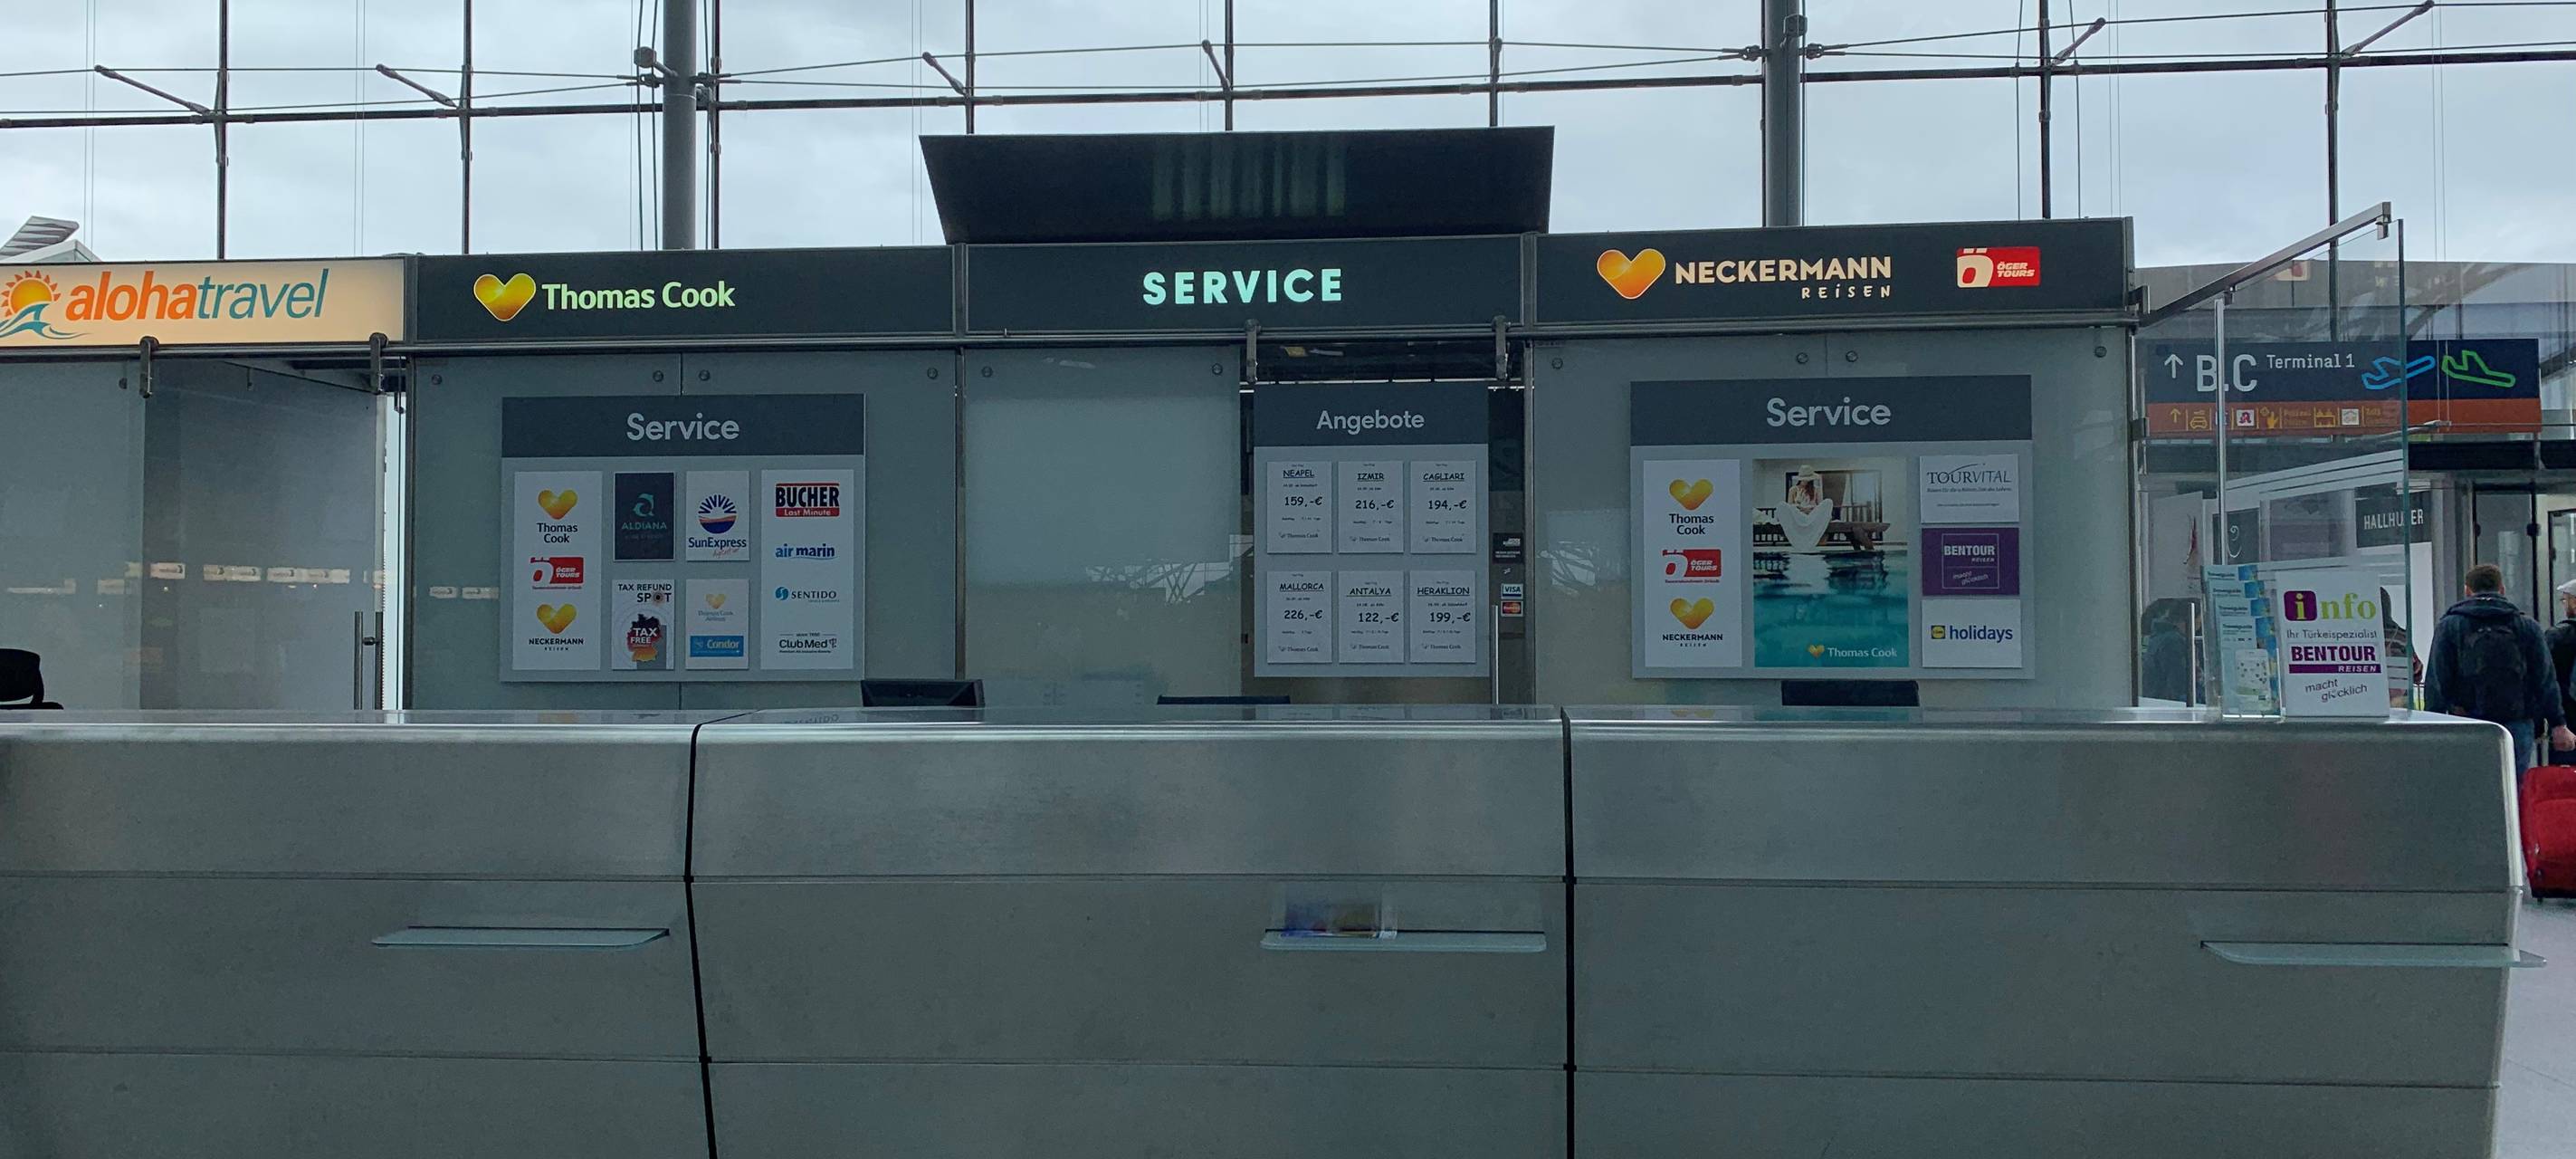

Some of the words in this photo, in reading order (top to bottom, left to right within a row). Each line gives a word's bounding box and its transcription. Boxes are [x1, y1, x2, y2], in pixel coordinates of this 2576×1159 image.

[1674, 256, 1892, 285] NECKERMANN
[1997, 261, 2028, 270] ÖGER
[1997, 269, 2035, 278] TOURS
[1142, 268, 1342, 306] SERVICE
[65, 268, 329, 321] alohatravel
[541, 283, 655, 310] Thomas
[662, 281, 736, 309] Cook
[2266, 353, 2342, 369] Terminal
[2346, 353, 2355, 369] 1
[1766, 397, 1892, 427] Service
[626, 412, 740, 441] Service
[1316, 410, 1426, 435] Angebote
[1283, 469, 1315, 478] NEAPEL
[1357, 473, 1385, 481] IZMIR
[1423, 473, 1465, 481] CAGLIARI
[1926, 469, 2012, 484] TOURVITAL
[775, 486, 840, 507] BUCHER
[1669, 513, 1714, 524] Thomas
[2363, 508, 2424, 530] HALLHUER
[536, 522, 578, 532] Thomas
[621, 522, 667, 530] ALDIANA
[1676, 524, 1706, 535] Cook
[543, 533, 570, 543] Cook
[688, 536, 747, 550] SunExpress
[775, 543, 794, 558] air
[796, 543, 835, 557] marin
[1943, 545, 1996, 556] BENTOUR
[618, 583, 634, 591] TAX
[636, 583, 673, 591] REFUND
[1279, 582, 1324, 590] MALLORCA
[1349, 587, 1391, 596] ANTALYA
[1417, 587, 1470, 595] HERAKLION
[791, 590, 837, 599] SENTIDO
[2294, 592, 2377, 620] info
[634, 627, 658, 637] TAX
[1949, 625, 2013, 644] holidays
[2287, 630, 2299, 638] Ihr
[2302, 629, 2377, 641] Türkeispezialist
[529, 637, 584, 646] NECKERMANN
[707, 639, 739, 649] Condor
[1827, 647, 1869, 657] Thomas
[1871, 647, 1898, 657] Cook
[2291, 646, 2376, 662] BENTOUR
[2305, 679, 2339, 694] macht
